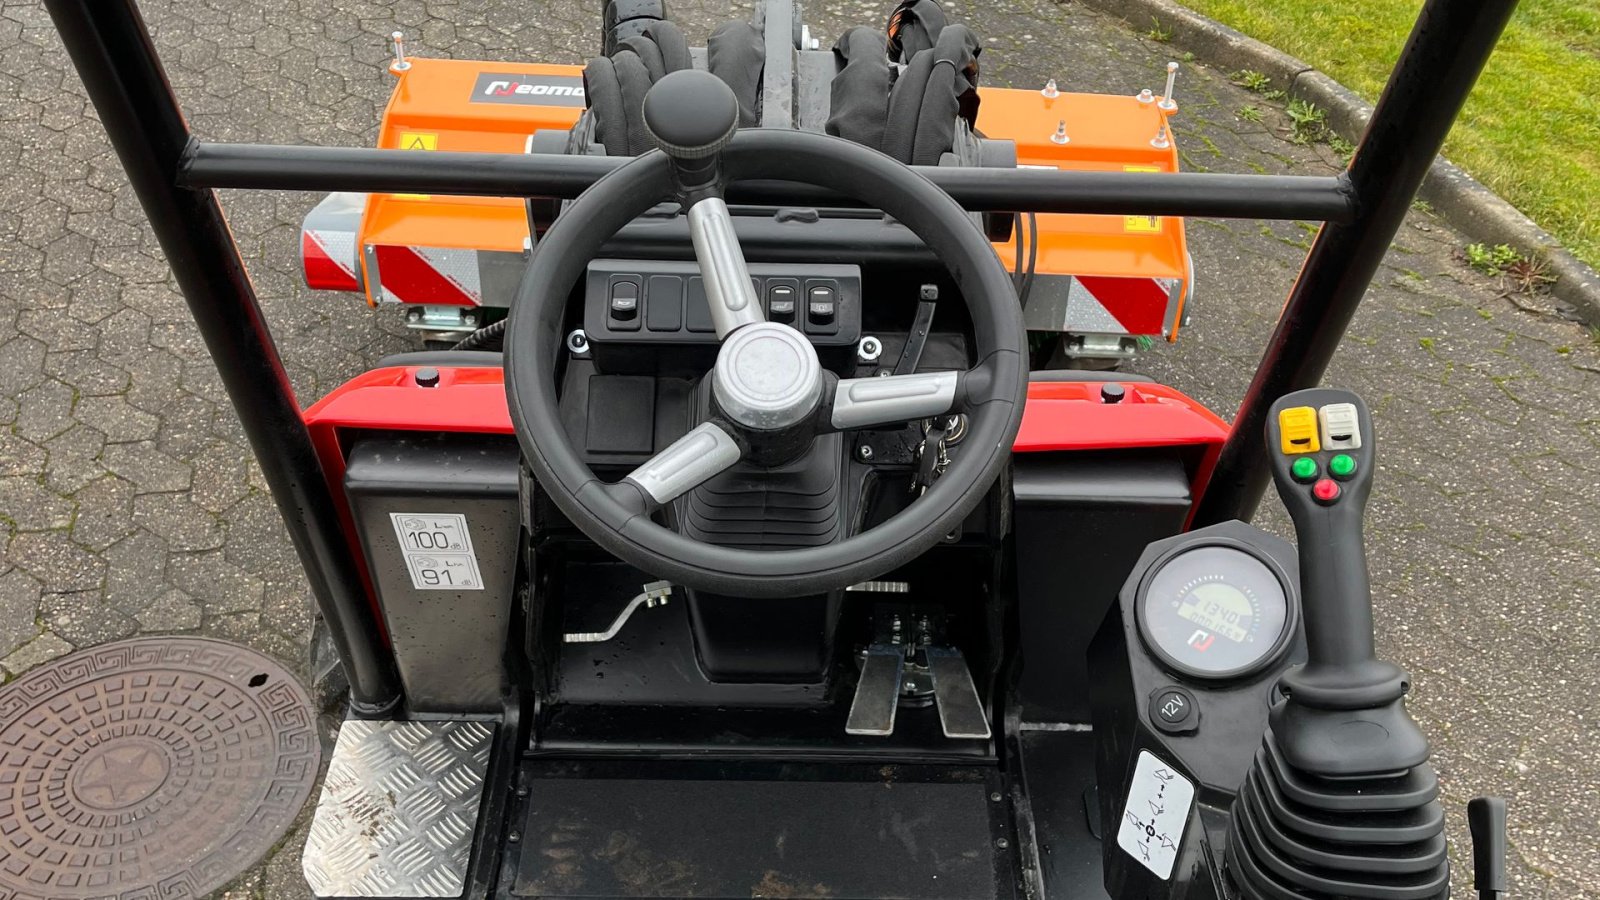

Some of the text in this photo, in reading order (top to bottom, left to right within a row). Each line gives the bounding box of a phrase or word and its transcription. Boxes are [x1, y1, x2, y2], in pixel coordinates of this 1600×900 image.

[409, 531, 449, 549] 100
[421, 569, 453, 585] 91
[1203, 600, 1239, 625] 1340
[1161, 695, 1184, 717] 12V
